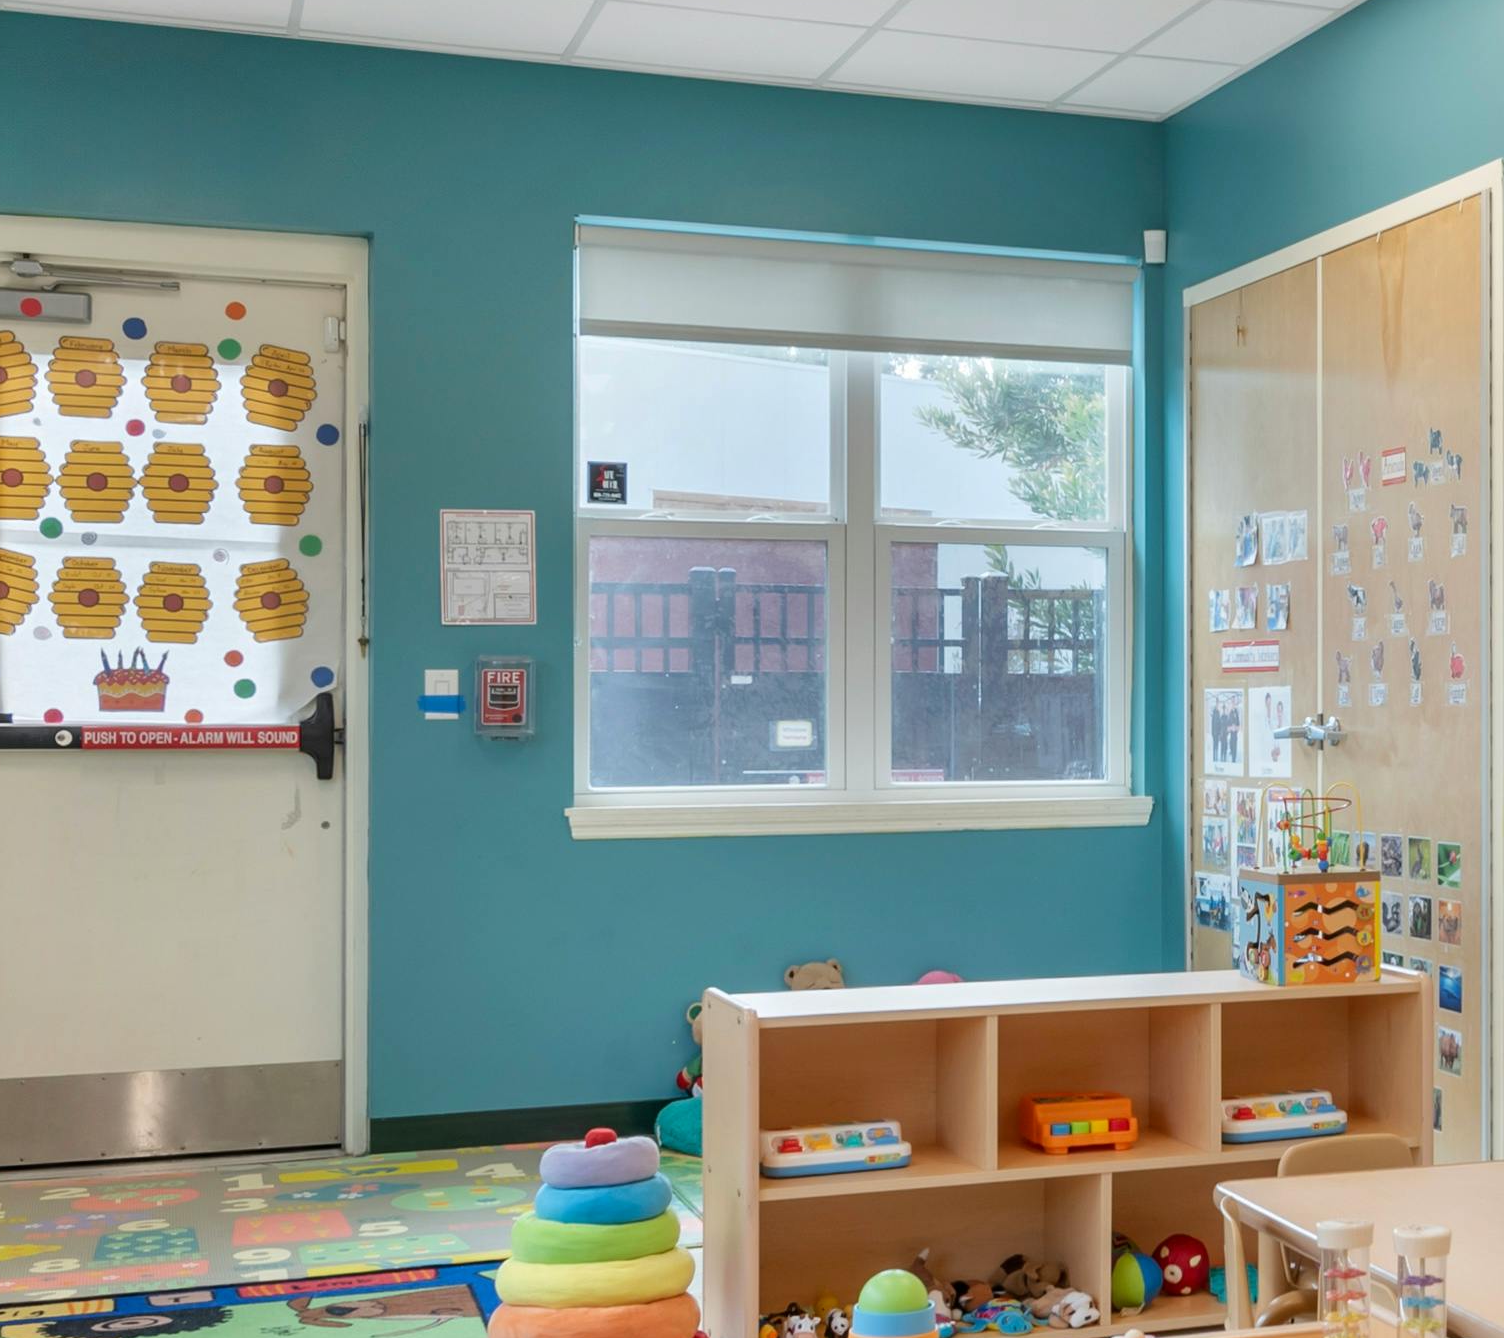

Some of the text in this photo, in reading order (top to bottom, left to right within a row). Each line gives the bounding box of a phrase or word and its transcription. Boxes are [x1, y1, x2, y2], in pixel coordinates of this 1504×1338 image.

[487, 672, 521, 684] FIRE
[83, 730, 298, 744] PUSH TO OPEN ALARM WILL SOUND
[465, 1163, 526, 1179] 4
[223, 1174, 274, 1191] 1
[358, 1221, 409, 1237] 5
[232, 1247, 292, 1265] 9
[28, 1258, 81, 1273] 8
